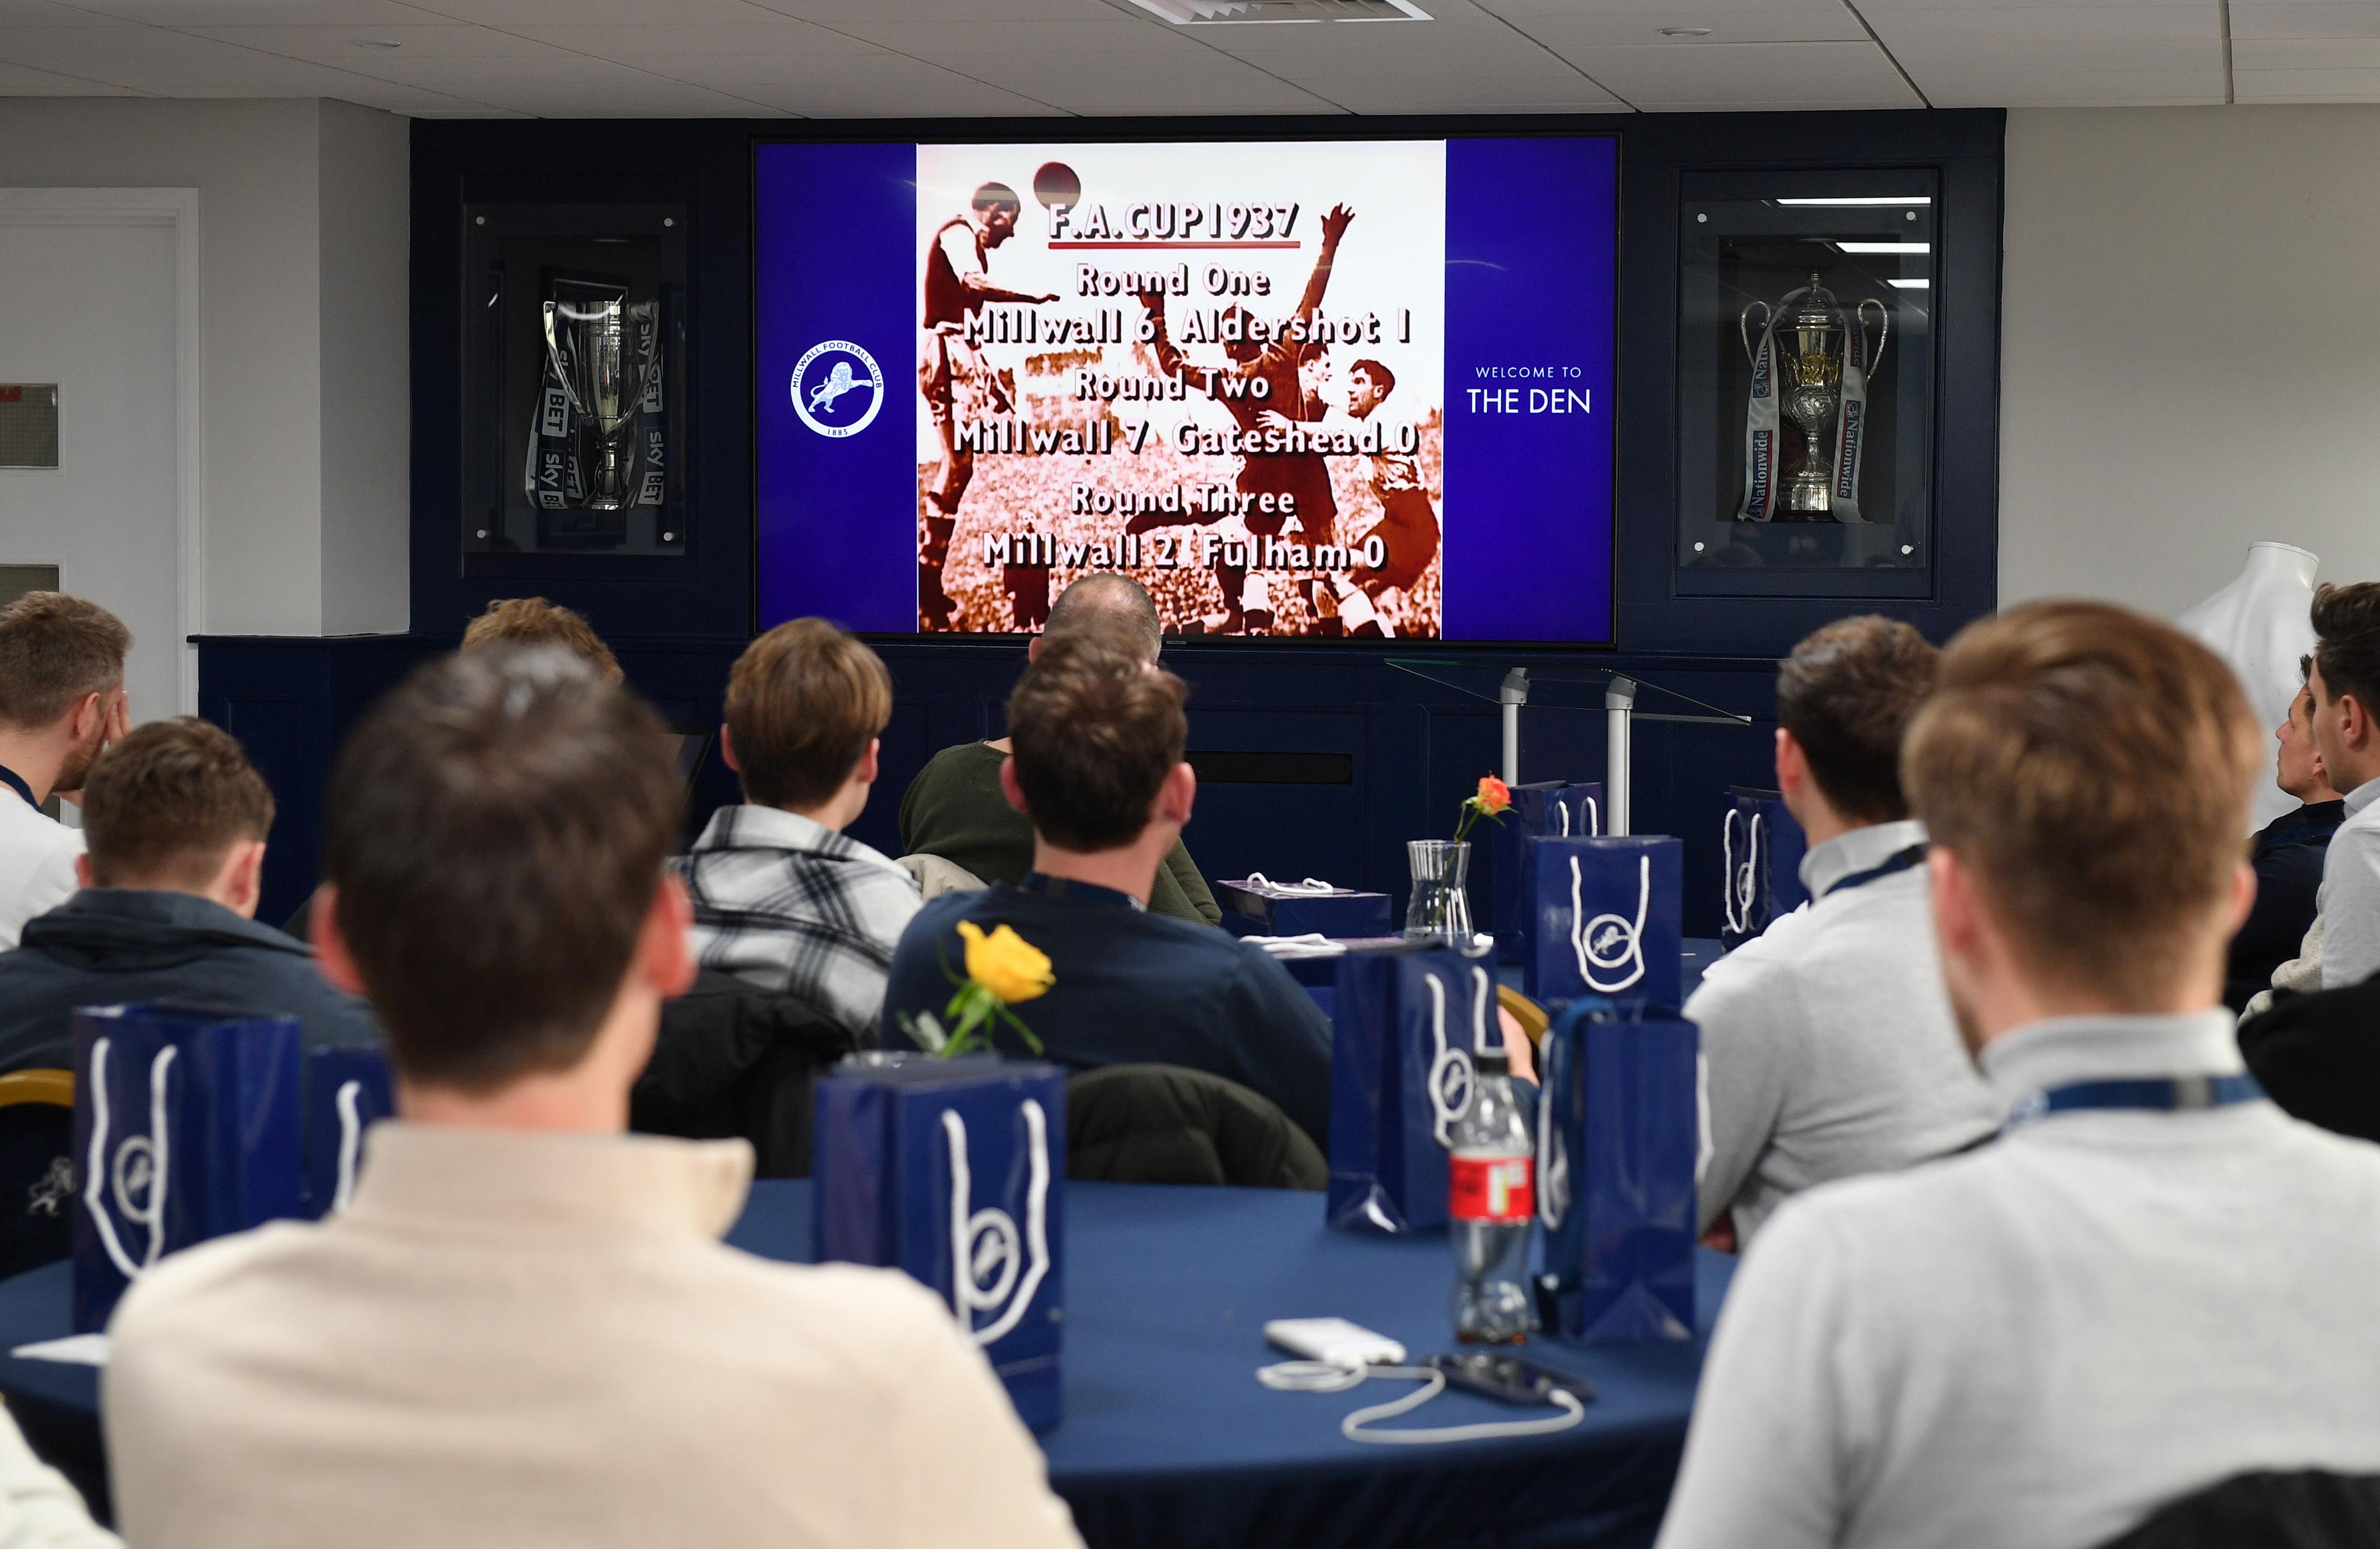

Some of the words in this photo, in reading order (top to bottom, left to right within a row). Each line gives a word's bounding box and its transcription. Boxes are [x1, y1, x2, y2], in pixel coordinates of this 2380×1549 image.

[1077, 263, 1188, 296] Round
[1202, 263, 1271, 296] One
[964, 308, 1122, 344] Millwall
[1135, 307, 1160, 343] 6
[1180, 307, 1380, 344] Aldershot
[793, 348, 822, 388] MILLWALL
[823, 342, 868, 362] FOOTBALL
[870, 363, 883, 388] CLUB
[1475, 367, 1554, 379] WELCOME
[1562, 367, 1582, 378] TO
[1075, 367, 1186, 401] Round
[1200, 368, 1272, 401] Two
[1466, 388, 1519, 414] THE
[1530, 388, 1590, 414] DEN
[548, 393, 565, 432] BET
[954, 419, 1113, 454] Millwall
[1125, 419, 1149, 455] 7
[1173, 419, 1382, 457] Gateshead
[1394, 419, 1420, 456] 0
[540, 452, 563, 488] sky
[1751, 431, 1768, 507] Nationwide
[1840, 419, 1859, 498] Nationwide
[644, 476, 663, 501] BET
[1072, 482, 1182, 515] Round
[1196, 483, 1298, 516] Three
[984, 532, 1142, 569] Millwall
[1155, 533, 1178, 569] 2
[1203, 534, 1352, 571] Fulham
[1364, 535, 1388, 571] 0
